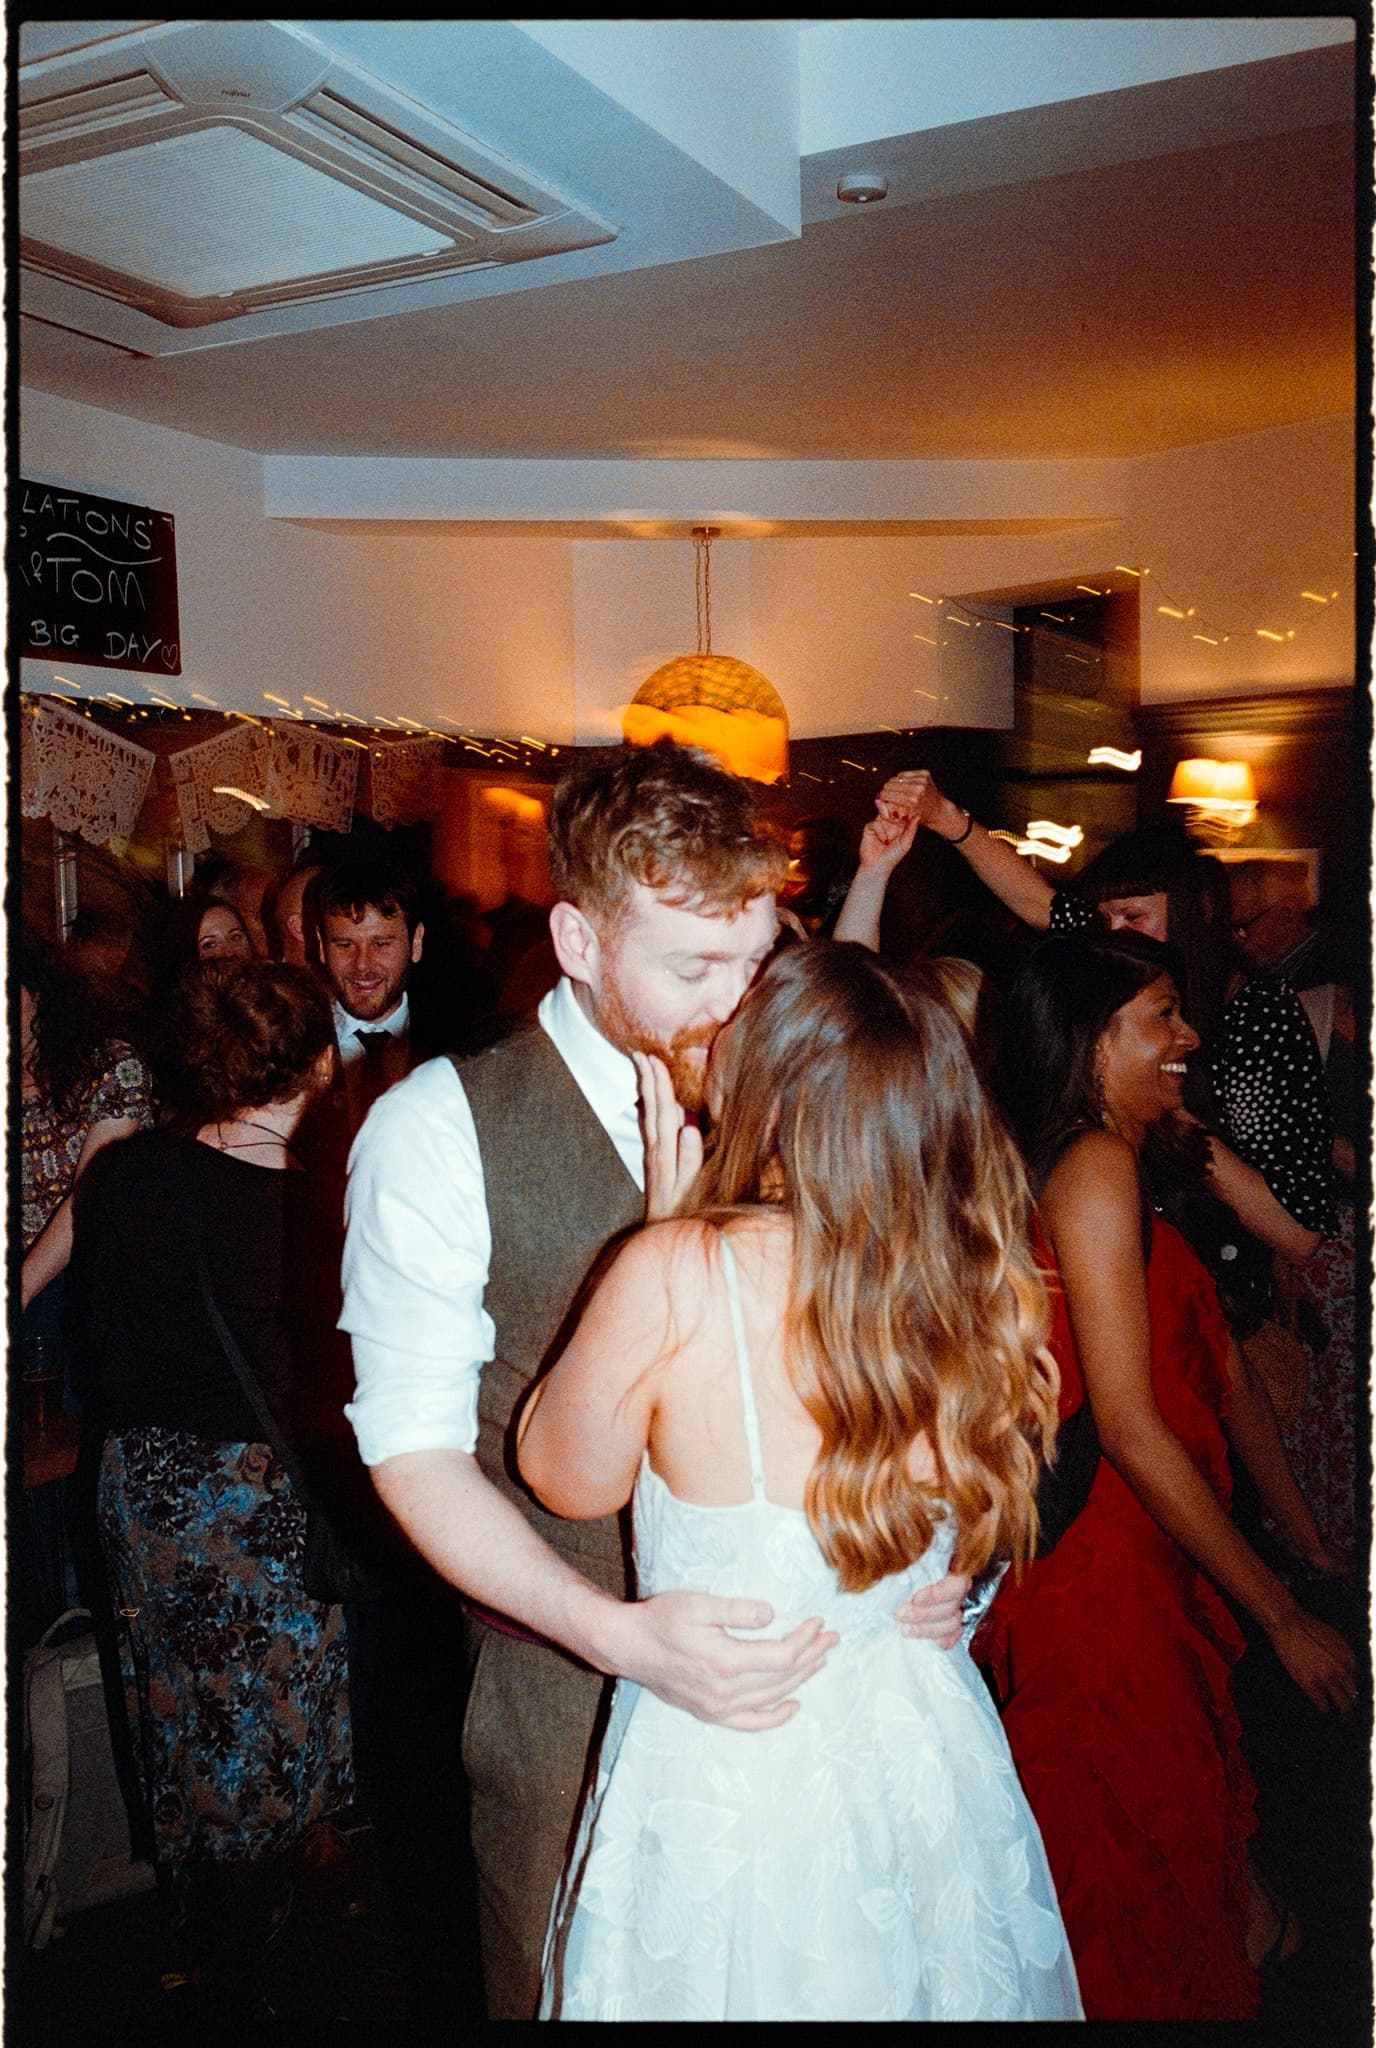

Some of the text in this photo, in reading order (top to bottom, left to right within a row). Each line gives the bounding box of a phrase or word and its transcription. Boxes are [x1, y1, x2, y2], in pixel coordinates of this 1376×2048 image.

[22, 490, 152, 550] LATIONS
[46, 558, 146, 612] TOM
[29, 619, 162, 663] BIG DAY
